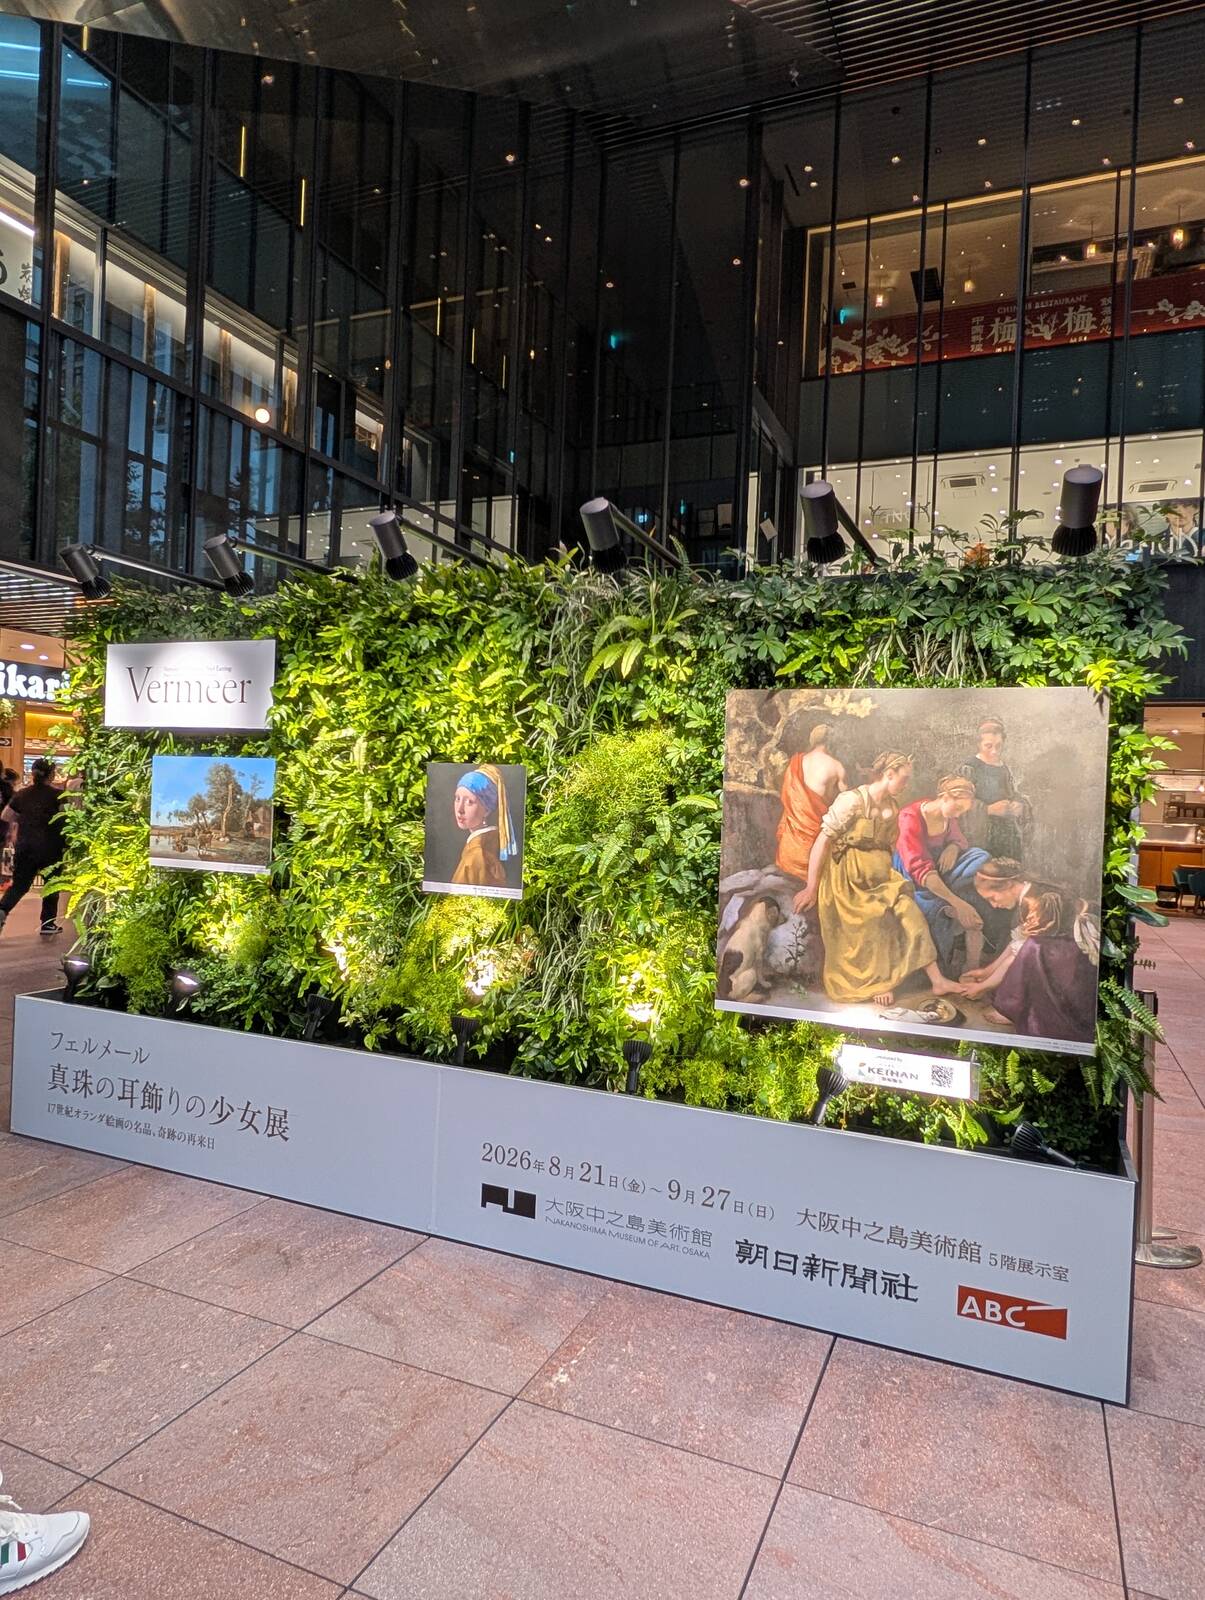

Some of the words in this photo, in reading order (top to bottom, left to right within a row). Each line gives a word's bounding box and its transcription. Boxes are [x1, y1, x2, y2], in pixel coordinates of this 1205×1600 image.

[1060, 304, 1097, 336] 梅
[126, 666, 252, 704] Vermeer
[50, 1031, 150, 1065] フェルメール
[867, 1066, 919, 1080] KEIHAN
[47, 1063, 291, 1142] 真珠の耳飾りの少女展
[47, 1102, 216, 1150] 17世紀オランダ絵画の名品、奇跡の再来日
[544, 1197, 713, 1248] 大阪中之島美術館
[545, 1216, 607, 1237] NAKANOSHIMA
[608, 1230, 646, 1245] MUSEUM
[648, 1239, 660, 1248] OF
[682, 1245, 711, 1259] OSAKA
[796, 1207, 982, 1265] 大阪中之島美術館
[988, 1252, 1070, 1283] 5階展示室
[735, 1238, 919, 1303] 朝日新聞社
[960, 1295, 1026, 1328] ABC
